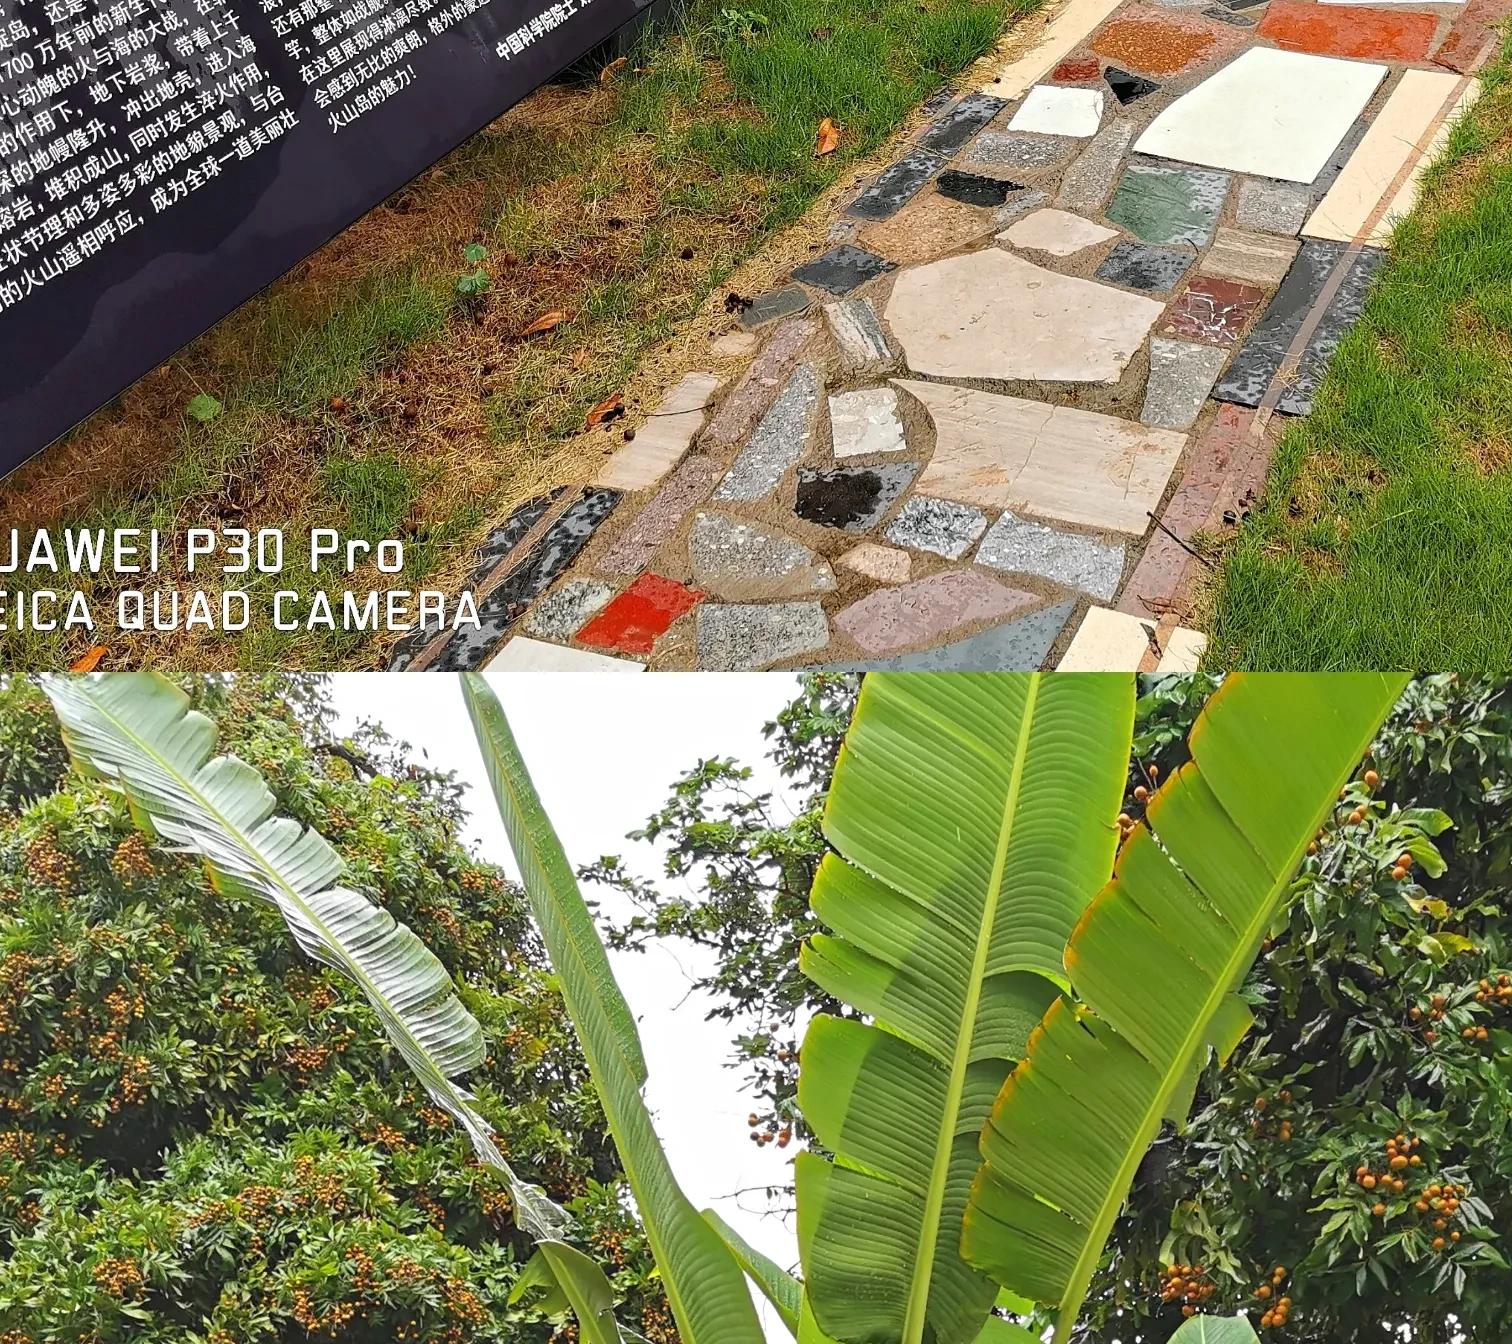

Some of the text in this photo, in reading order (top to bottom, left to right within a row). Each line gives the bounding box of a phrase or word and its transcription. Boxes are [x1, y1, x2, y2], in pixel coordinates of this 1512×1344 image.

[327, 64, 417, 133] 火山岛的魅力！
[0, 108, 300, 313] 的火山遥相呼应，成为全球一道美丽壮
